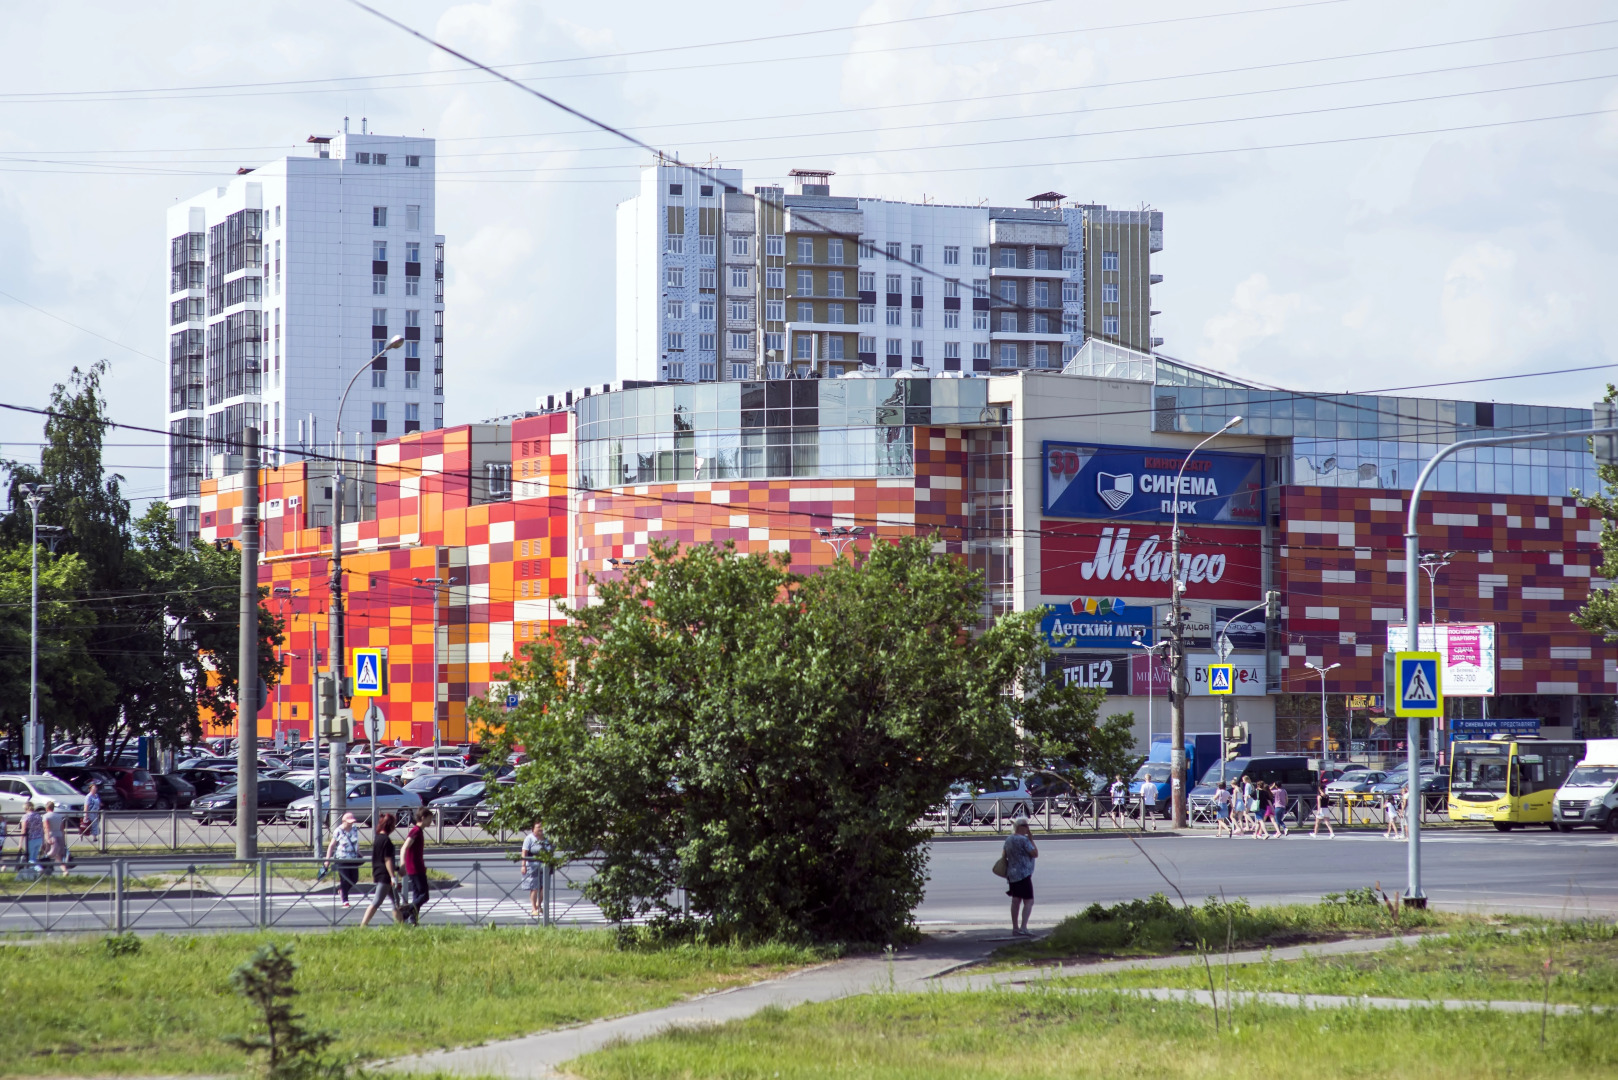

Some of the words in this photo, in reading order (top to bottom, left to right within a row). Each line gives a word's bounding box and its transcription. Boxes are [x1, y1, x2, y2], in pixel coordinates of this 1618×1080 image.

[1050, 450, 1079, 475] 3D
[1145, 457, 1212, 471] КИНОТЕАТР
[1139, 474, 1218, 496] СИНЕМА
[1247, 483, 1260, 506] 7
[1161, 500, 1197, 514] ПАРК
[1051, 618, 1113, 637] Детский
[1062, 660, 1114, 689] TELE2
